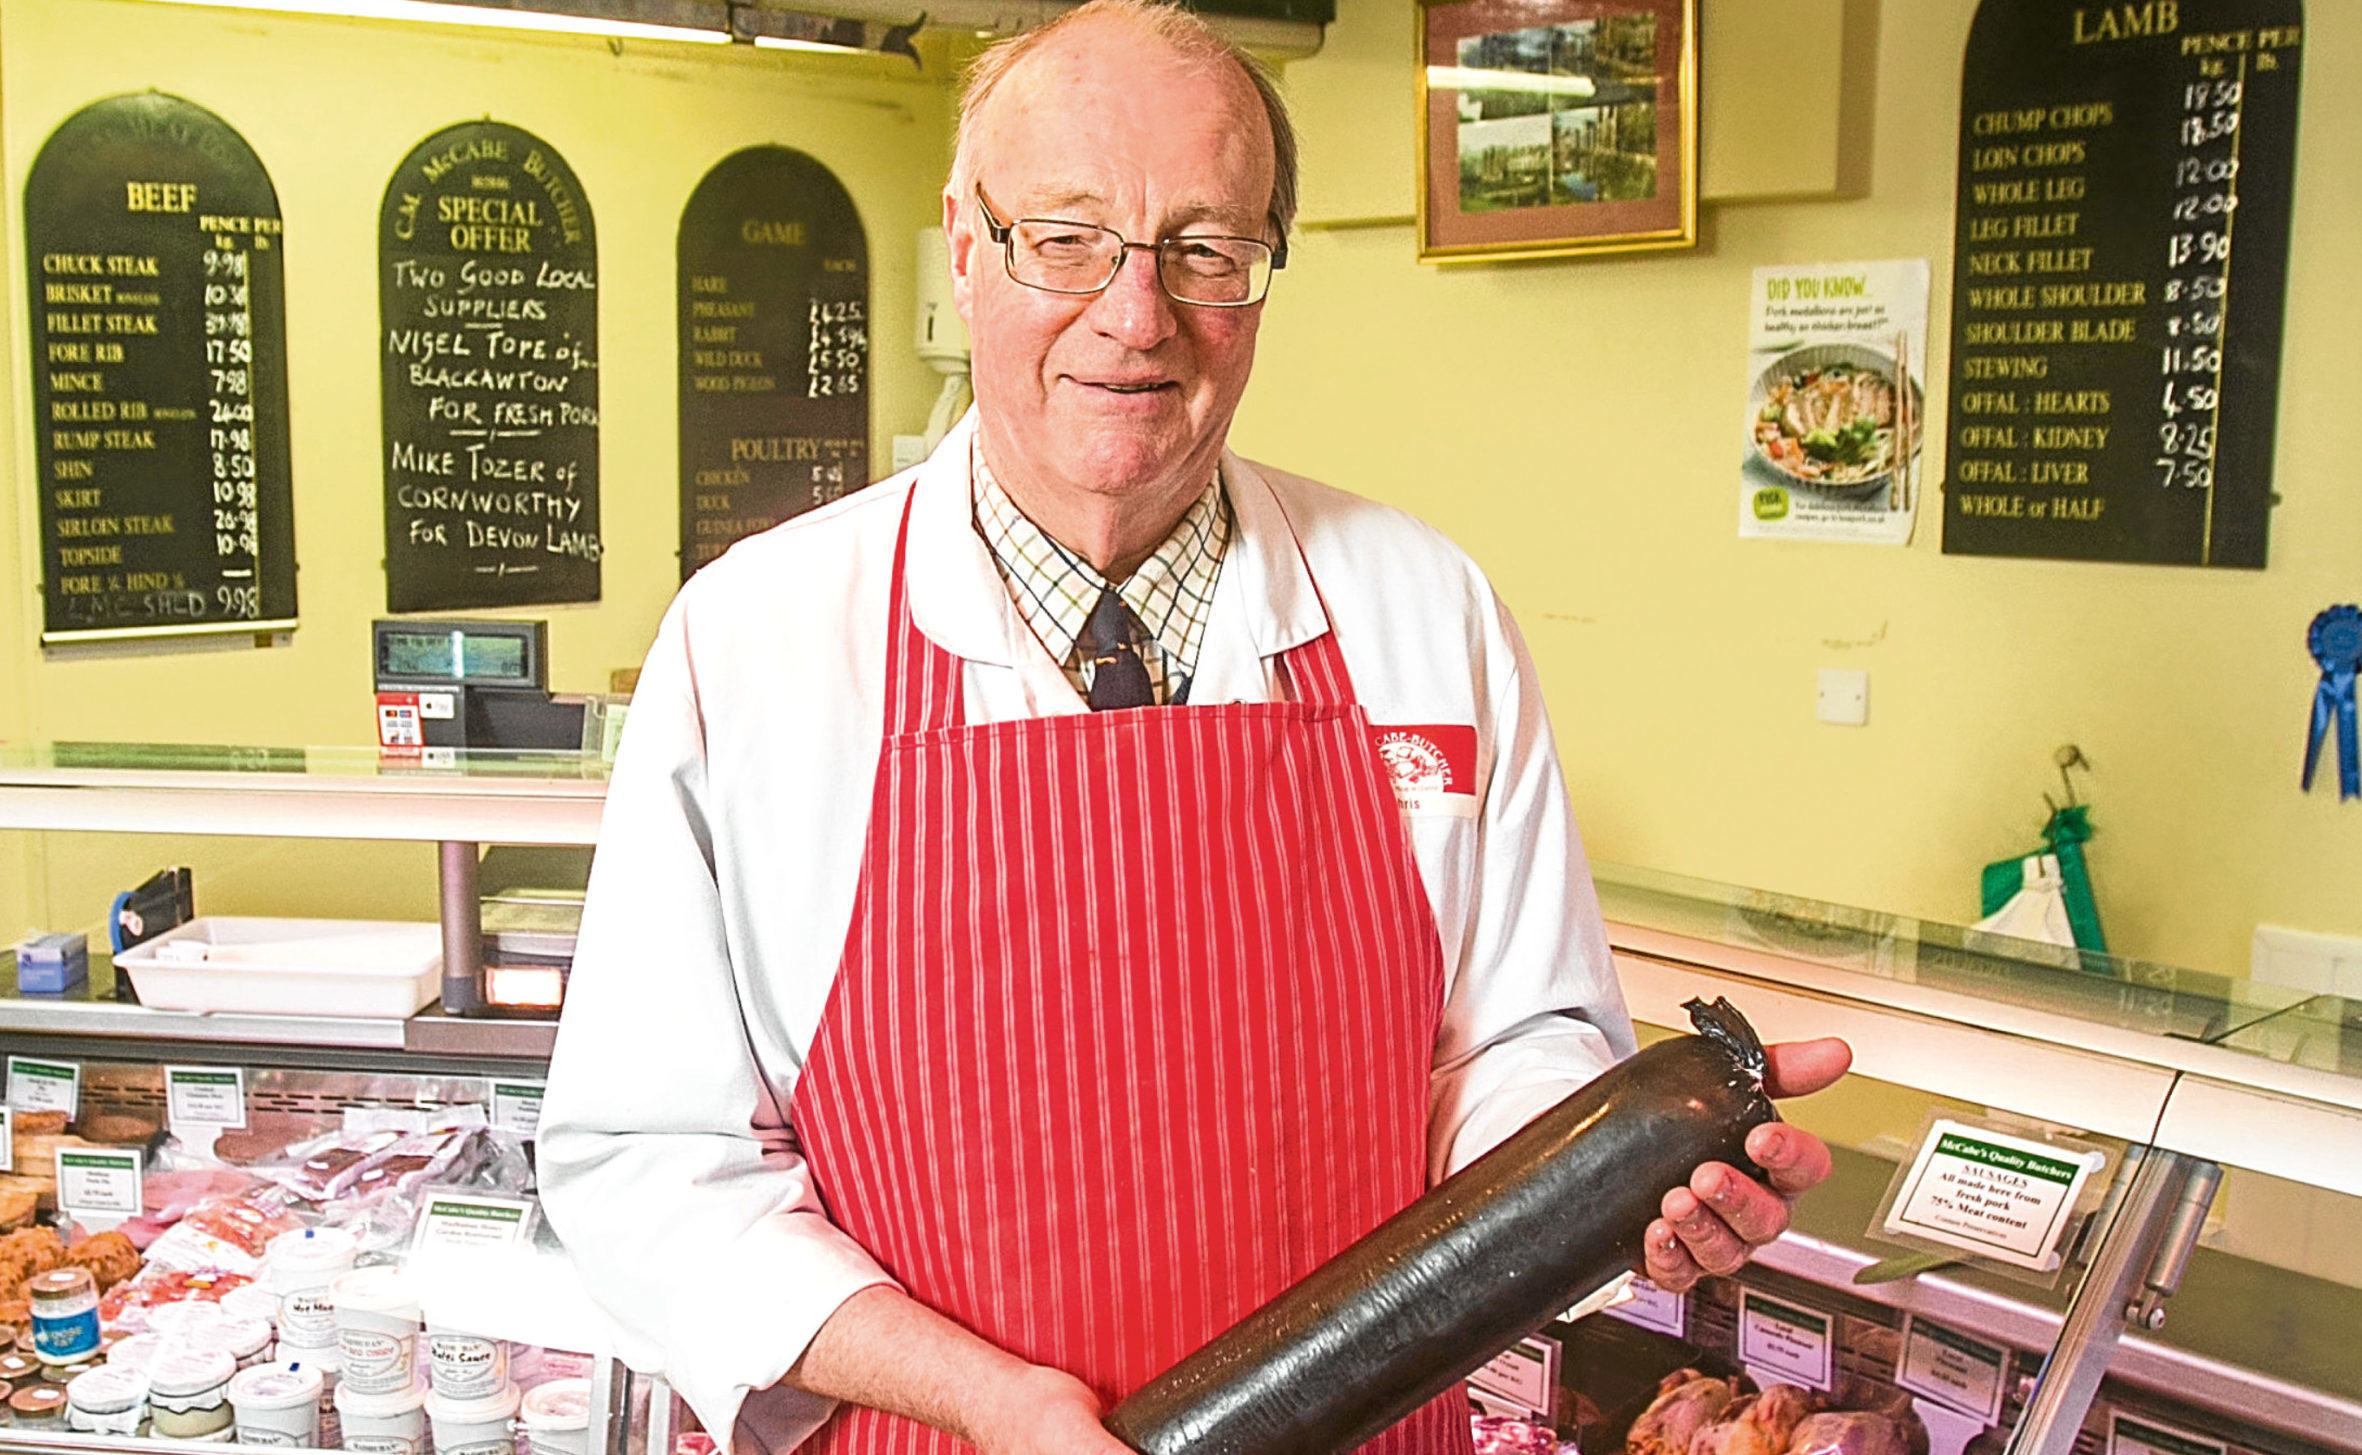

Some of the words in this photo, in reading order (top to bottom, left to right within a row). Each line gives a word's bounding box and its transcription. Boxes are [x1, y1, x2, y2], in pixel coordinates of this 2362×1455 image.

[2073, 1, 2179, 43] LAMB
[2181, 31, 2250, 56] PENCE
[2258, 26, 2300, 49] PER
[1972, 109, 2046, 137] CHUMP
[2050, 102, 2113, 128] CHOPS
[1972, 148, 2018, 173] LOIN
[2022, 141, 2086, 166] CHOPS
[127, 181, 198, 213] BEEF
[1972, 180, 2040, 205] WHOLE
[2046, 177, 2086, 202] LEG
[437, 195, 544, 227] SPECIAL
[200, 215, 249, 233] PENCE
[254, 217, 283, 234] PER
[742, 218, 806, 245] GAME
[1970, 217, 2009, 241] LEG
[2013, 212, 2080, 239] FILLET
[451, 223, 532, 252] OFFER
[43, 254, 103, 276] CHUCK
[106, 256, 159, 277] STEAK
[1969, 254, 2021, 277] NECK
[2026, 248, 2094, 273] FILLET
[46, 283, 112, 304] BRISKET
[1767, 278, 1790, 300] DID
[1795, 277, 1819, 299] YOU
[1968, 286, 2036, 310] WHOLE
[2039, 283, 2147, 308] SHOULDER
[424, 295, 547, 320] SUPPLIERS
[47, 314, 103, 333] FILLET
[106, 315, 158, 335] STEAK
[1965, 321, 2064, 345] SHOULDER
[2069, 318, 2137, 343] BLADE
[48, 343, 90, 363] FORE
[96, 344, 124, 363] RIB
[388, 329, 471, 364] NIGEL
[409, 363, 569, 392] BLACKAWTON
[1963, 356, 2048, 380] STEWING
[51, 373, 103, 391] MINCE
[51, 402, 116, 421] ROLLED
[120, 402, 148, 419] RIB
[429, 396, 483, 425] FOR
[494, 402, 553, 427] FRESH
[1961, 392, 2019, 415] OFFAL
[2034, 391, 2111, 415] HEARTS
[53, 431, 100, 450] RUMP
[104, 430, 156, 449] STEAK
[732, 438, 821, 461] POULTRY
[1960, 427, 2018, 450] OFFAL
[2032, 427, 2111, 450] KIDNEY
[54, 460, 93, 479] SHIN
[392, 440, 454, 475] MIKE
[465, 443, 545, 479] TOZER
[1959, 461, 2017, 484] OFFAL
[2031, 462, 2090, 485] LIVER
[56, 490, 101, 508] SKIRT
[398, 483, 581, 523] CORNWORTHY
[1959, 494, 2025, 518] WHOLE
[2028, 502, 2046, 518] or
[2052, 497, 2105, 520] HALF
[57, 518, 120, 537] SIRLOIN
[123, 514, 174, 535] STEAK
[466, 519, 539, 549] DEVON
[60, 546, 122, 567] TOPSIDE
[61, 575, 100, 594] FORE
[127, 573, 168, 590] HIND
[1397, 798, 1420, 810] hris
[1940, 1139, 1987, 1158] McCabe's
[1988, 1151, 2026, 1169] Quality
[2027, 1160, 2072, 1179] Butchers
[1941, 1172, 1956, 1183] All
[1957, 1176, 1985, 1190] made
[1989, 1185, 2011, 1197] here
[2014, 1191, 2041, 1205] from
[1964, 1165, 2028, 1188] SAUSAGES
[1931, 1195, 1954, 1210] 75%
[1957, 1203, 1984, 1218] Meat
[1986, 1212, 2028, 1229] content
[1956, 1189, 1982, 1203] fresh
[1984, 1197, 2010, 1211] pork
